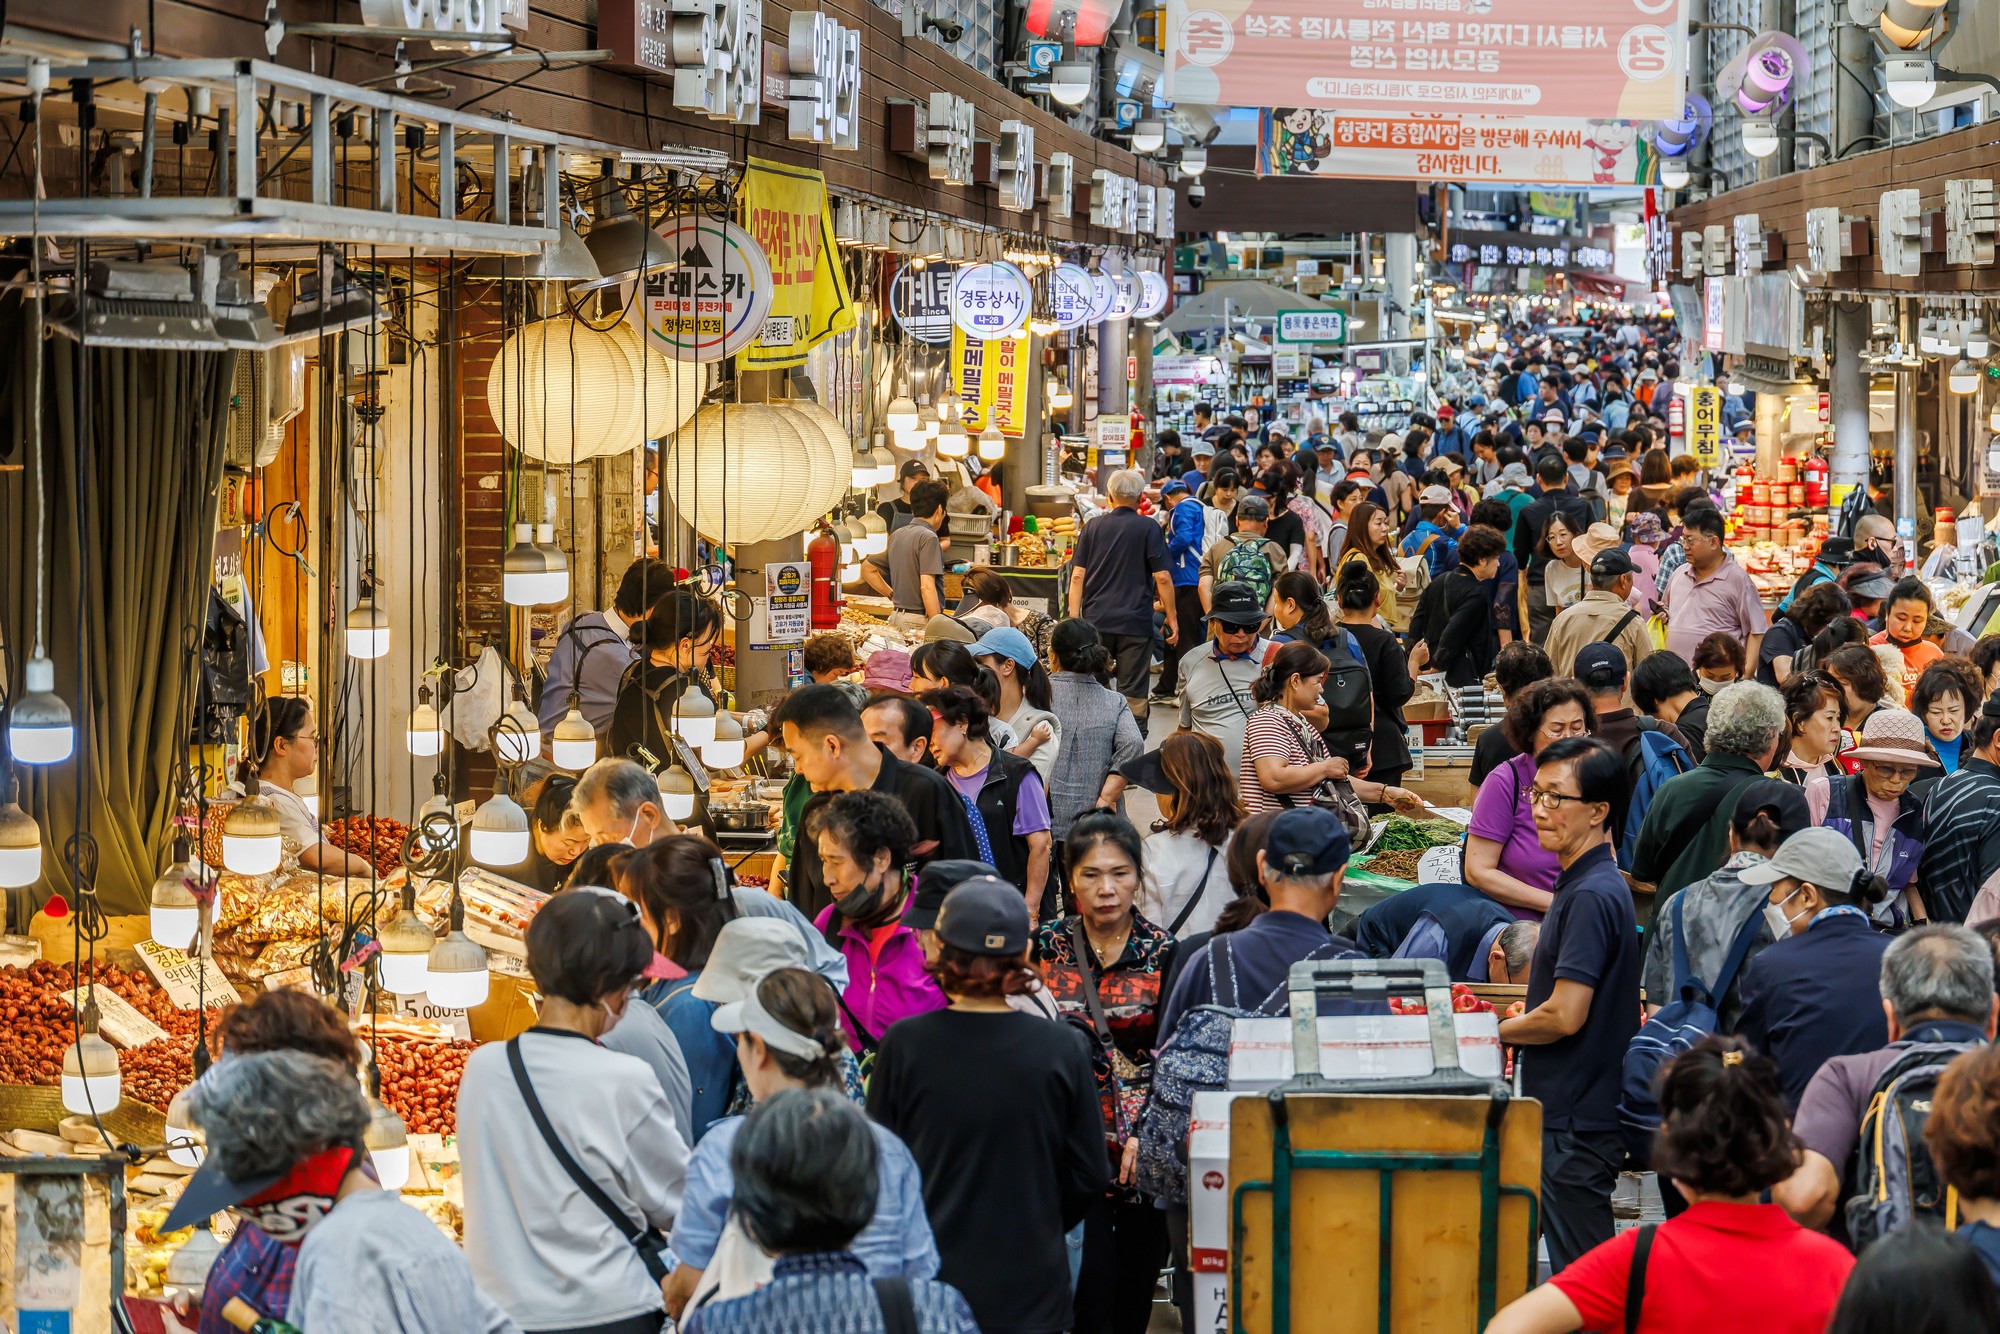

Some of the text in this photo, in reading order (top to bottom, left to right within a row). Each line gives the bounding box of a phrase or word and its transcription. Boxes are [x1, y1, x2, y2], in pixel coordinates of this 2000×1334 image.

[1338, 121, 1582, 149] 청량리 종합시장을 방문해 주셔서
[1416, 153, 1502, 175] 감사합니다.
[643, 271, 746, 299] 알래스카
[654, 301, 733, 313] 프리미엄 퓨전카페
[959, 290, 1020, 309] 경동상사
[922, 308, 946, 316] Since
[996, 336, 1017, 427] 말이 메밀국수
[1696, 392, 1715, 454] 홍어무침
[1207, 692, 1256, 706] Marmo
[154, 948, 186, 968] 경산
